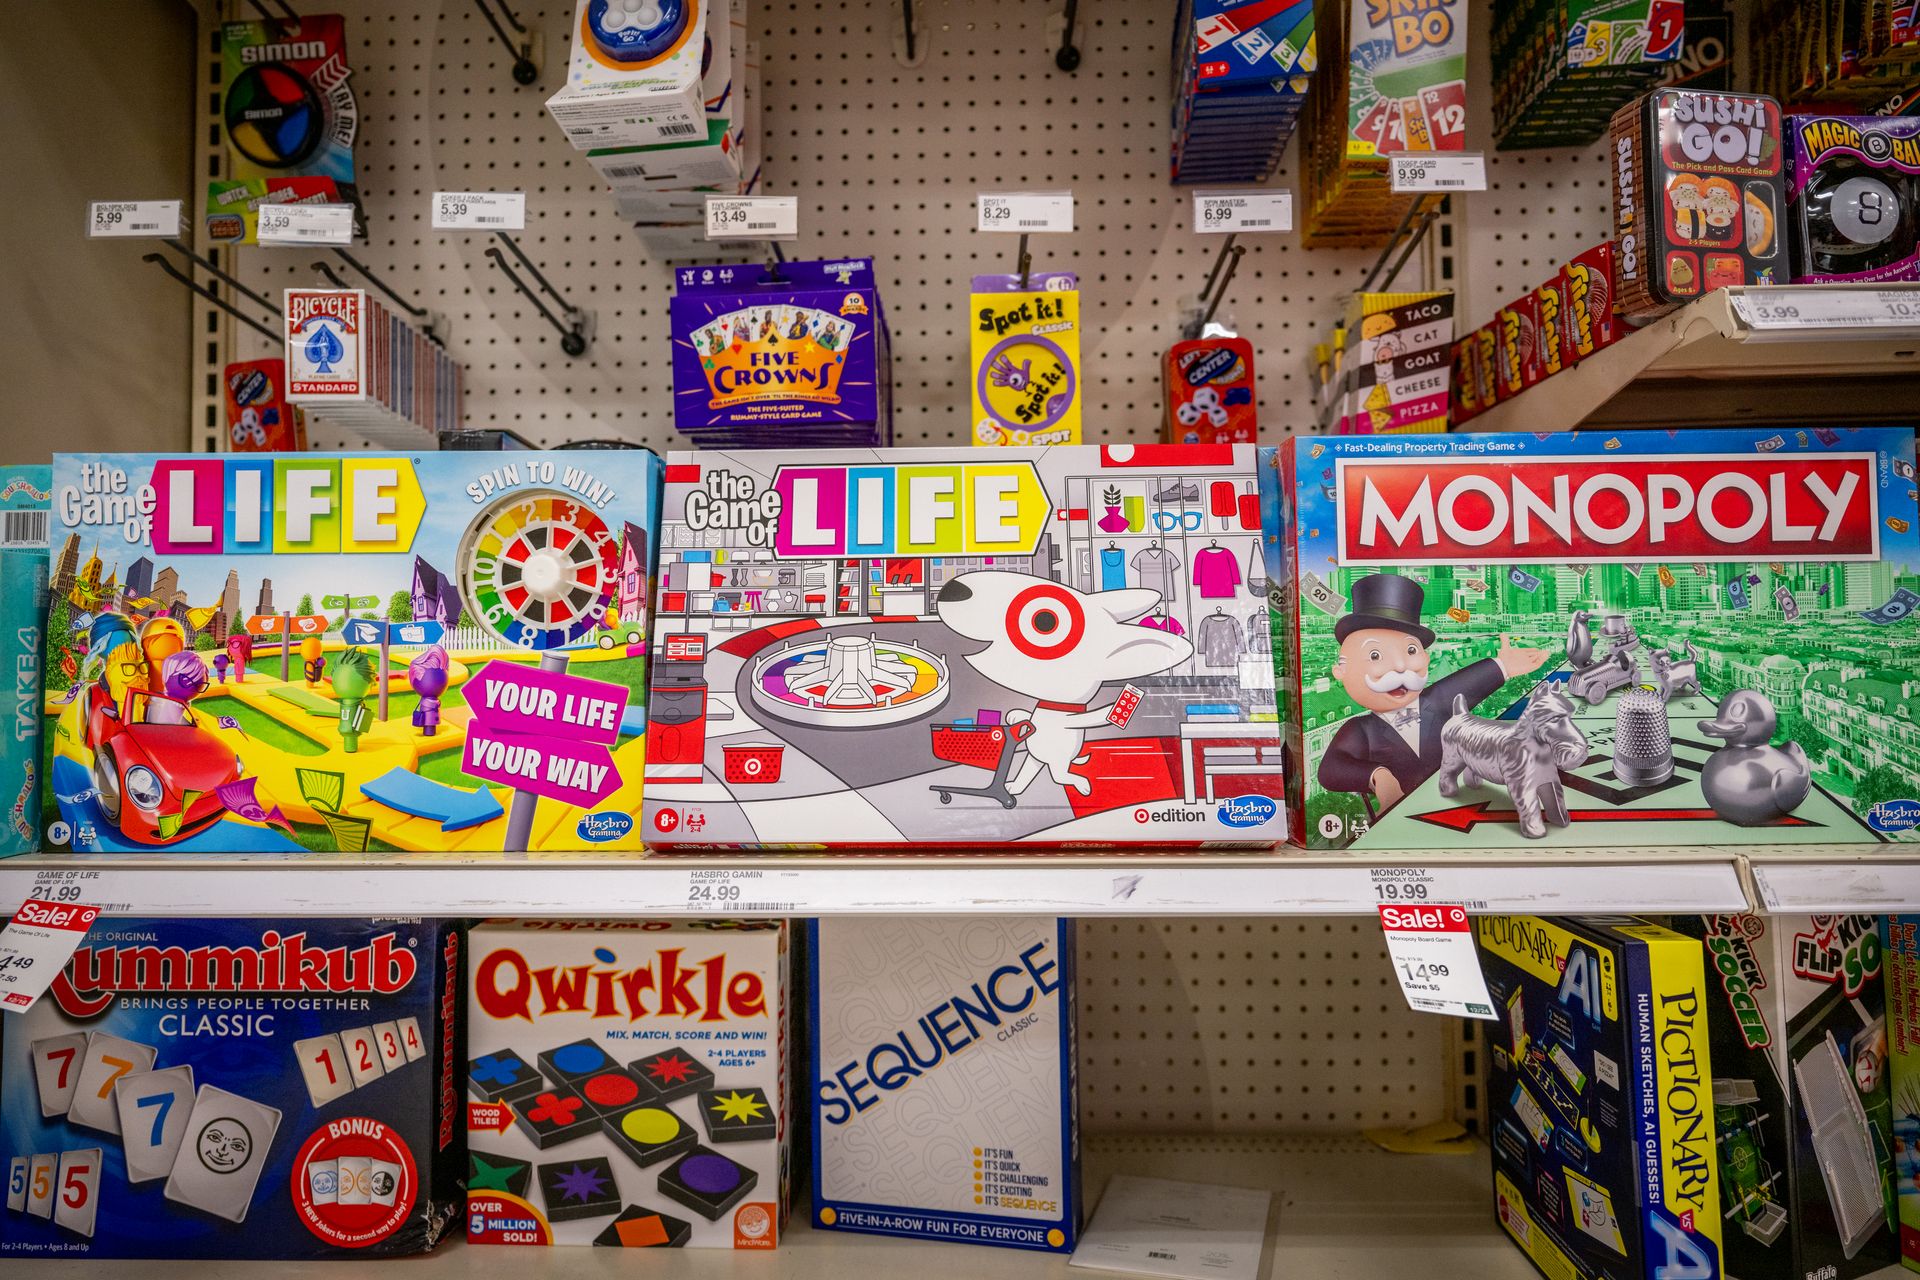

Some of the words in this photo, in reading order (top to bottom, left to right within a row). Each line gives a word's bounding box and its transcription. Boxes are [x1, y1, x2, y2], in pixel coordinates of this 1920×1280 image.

[1392, 10, 1454, 57] BO
[1431, 104, 1465, 136] 12
[1681, 123, 1764, 166] GO!
[1804, 120, 1861, 158] MAGIC
[1397, 168, 1426, 180] 9.99
[1671, 161, 1685, 171] The
[1686, 162, 1702, 172] Pick
[1703, 164, 1717, 173] and
[1718, 165, 1735, 174] Pass
[1736, 166, 1753, 175] Card
[1754, 167, 1773, 177] Game
[440, 203, 468, 216] 5.39
[712, 210, 747, 224] 13.49
[983, 207, 1011, 220] 8.29
[1204, 207, 1232, 221] 6.99
[1859, 191, 1883, 225] 8
[96, 211, 124, 225] 5.99
[262, 215, 291, 229] 3.59
[1621, 233, 1637, 281] GO!
[293, 297, 356, 331] BICYCLE
[979, 299, 1032, 335] Spot
[1035, 297, 1063, 321] it!
[1405, 303, 1442, 322] TACO
[1757, 306, 1799, 318] 3.99
[1413, 328, 1439, 344] CAT
[751, 350, 800, 367] FIVE
[1188, 350, 1232, 384] CENTER
[1404, 351, 1441, 370] GOAT
[293, 383, 357, 392] STANDARD
[714, 362, 835, 394] CROWNS
[1394, 376, 1442, 396] CHEESE
[1400, 400, 1439, 419] PIZZA
[1344, 442, 1402, 453] Fast-Dealing
[1404, 442, 1447, 453] Property
[1449, 441, 1485, 453] Trading
[1487, 441, 1516, 451] Game
[81, 462, 129, 493] the
[465, 462, 521, 504] SPIN
[526, 461, 555, 483] TO
[561, 465, 616, 509] WIN!
[708, 470, 754, 500] the
[59, 483, 157, 528] Game
[168, 469, 398, 543] LIFE
[685, 489, 783, 531] Game
[791, 475, 1021, 547] LIFE
[1358, 470, 1861, 548] MONOPOLY
[123, 513, 154, 547] of
[746, 520, 778, 549] of
[15, 626, 42, 742] TAKE4
[484, 679, 558, 721] YOUR
[562, 694, 619, 731] LIFE
[471, 737, 542, 780] YOUR
[546, 754, 610, 794] WAY
[1151, 808, 1206, 823] edition
[1218, 800, 1273, 815] Hasbro
[579, 815, 629, 830] Hasbro
[660, 813, 677, 828] 8+
[1229, 811, 1267, 825] Gaming
[1325, 820, 1340, 833] 8+
[54, 826, 69, 838] 8+
[588, 828, 622, 838] Gaming
[37, 871, 67, 879] GAME
[67, 871, 79, 879] OF
[80, 871, 100, 879] LIFE
[691, 871, 730, 879] HASBRO
[731, 871, 763, 879] GAMIN
[1370, 868, 1426, 877] MONOPOLY
[30, 886, 82, 901] 21.99
[688, 885, 741, 901] 24.99
[1374, 883, 1428, 900] 19.99
[17, 903, 78, 927] Sale!
[1382, 908, 1445, 929] Sale!
[105, 932, 159, 942] ORIGINAL
[1390, 935, 1417, 943] Monopoly
[1480, 914, 1563, 971] PICTIONARY
[1730, 937, 1762, 987] KICK
[475, 946, 769, 1024] Qwirkle
[1404, 981, 1428, 991] Save
[1428, 983, 1441, 992] $5
[1558, 948, 1601, 1024] AI
[1708, 936, 1769, 1045] SOCCER
[120, 998, 189, 1010] BRINGS
[197, 998, 265, 1010] PEOPLE
[270, 998, 371, 1011] TOGETHER
[158, 1014, 275, 1038] CLASSIC
[995, 1011, 1040, 1043] CLASSIC
[1637, 992, 1650, 1043] HUMAN
[407, 1025, 419, 1049] 4
[606, 1030, 631, 1041] MIX,
[631, 1030, 673, 1041] MATCH,
[674, 1030, 712, 1040] SCORE
[714, 1030, 739, 1040] AND
[741, 1030, 767, 1040] WIN!
[819, 940, 1061, 1126] SEQUENCE
[383, 1031, 397, 1058] 3
[707, 1050, 724, 1058] 2-4
[725, 1050, 767, 1058] PLAYERS
[355, 1038, 373, 1072] 2
[718, 1059, 743, 1067] AGES
[744, 1059, 756, 1067] 6+
[47, 1046, 76, 1089] 7
[315, 1048, 337, 1085] 1
[97, 1054, 134, 1100] 7
[1641, 1046, 1655, 1119] SKETCHES,
[1659, 986, 1711, 1213] PICTIONARY
[137, 1091, 176, 1147] 7
[472, 1108, 501, 1118] WOOD
[472, 1117, 500, 1126] TILES!
[327, 1119, 385, 1142] BONUS
[1644, 1121, 1656, 1136] AI
[984, 1148, 999, 1159] IT'S
[999, 1149, 1014, 1160] FUN
[984, 1160, 999, 1171] IT'S
[999, 1161, 1021, 1173] QUICK
[1645, 1139, 1661, 1204] GUESSES!
[11, 1165, 25, 1195] 5
[33, 1166, 50, 1199] 5
[62, 1165, 91, 1209] 5
[984, 1172, 999, 1183] IT'S
[999, 1173, 1049, 1187] CHALLENGING
[985, 1184, 999, 1195] IT'S
[999, 1186, 1033, 1198] EXCITING
[301, 1200, 310, 1208] 3
[394, 1201, 408, 1221] play!
[470, 1202, 503, 1213] OVER
[985, 1196, 999, 1207] IT'S
[1000, 1197, 1057, 1213] SEQUENCE
[304, 1206, 319, 1223] NEW
[387, 1218, 396, 1228] to
[316, 1220, 336, 1238] Jokers
[376, 1223, 390, 1237] way
[470, 1215, 485, 1235] 5
[487, 1219, 537, 1231] MILLION
[839, 1211, 923, 1231] FIVE-IN-A-ROW
[925, 1219, 950, 1233] FUN
[952, 1222, 978, 1237] FOR
[980, 1225, 1045, 1243] EVERYONE
[336, 1230, 347, 1241] for
[352, 1229, 377, 1242] second
[502, 1232, 538, 1243] SOLD!
[1, 1242, 11, 1251] For
[11, 1242, 22, 1250] 2-4
[22, 1243, 43, 1253] Players
[48, 1243, 64, 1253] Ages
[64, 1243, 68, 1251] 8
[68, 1243, 80, 1252] and
[80, 1244, 90, 1253] Up
